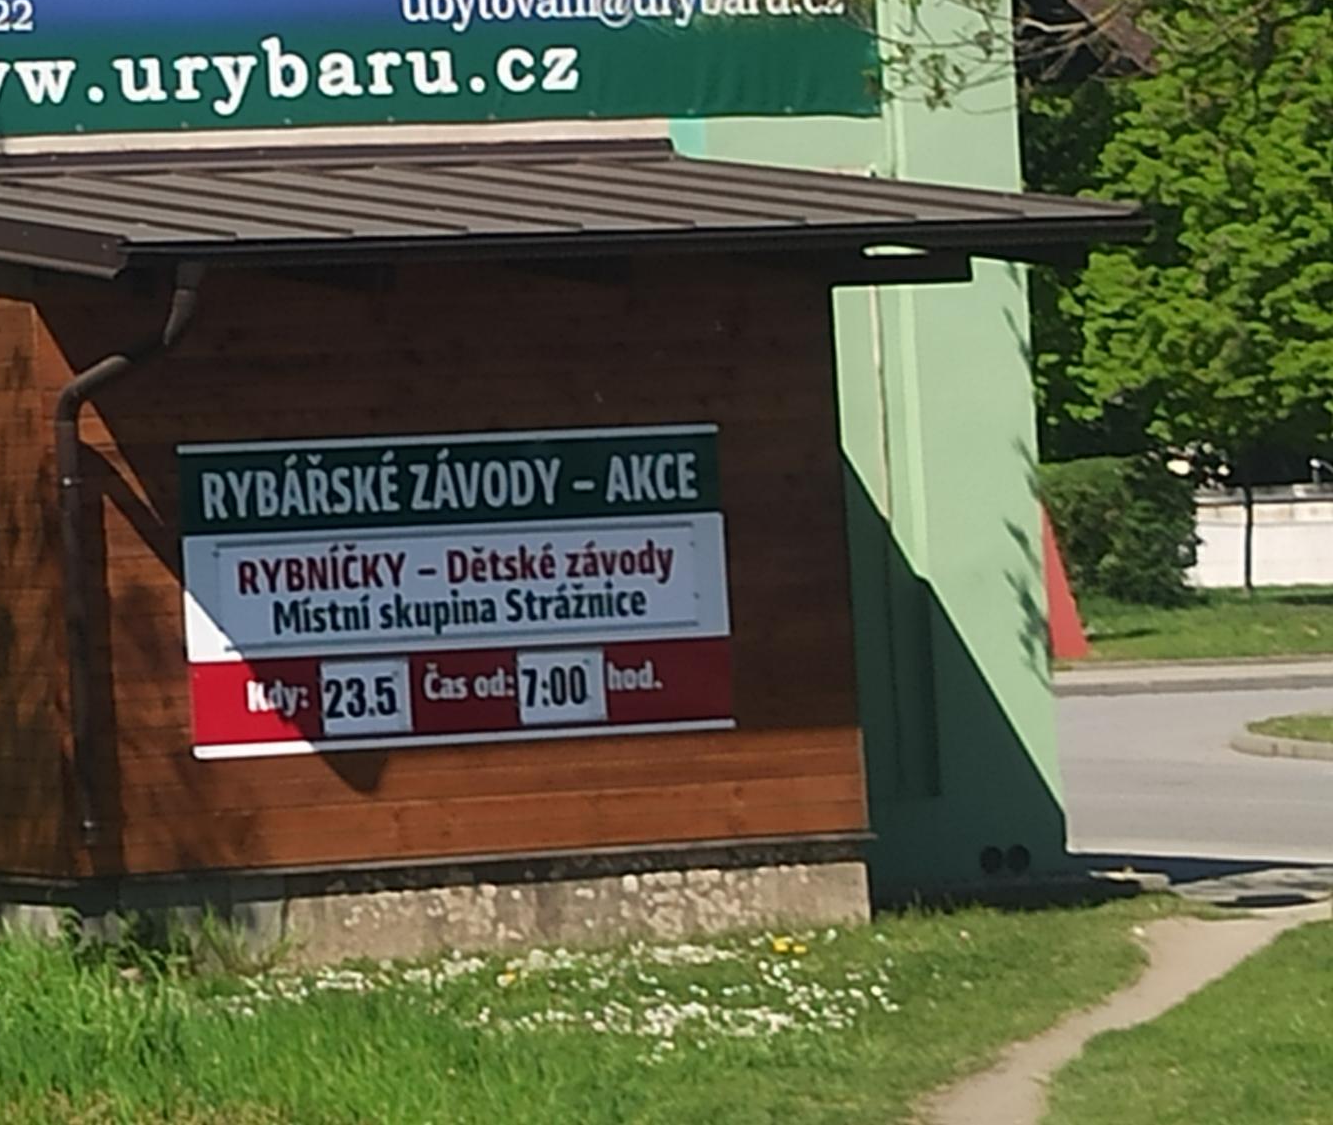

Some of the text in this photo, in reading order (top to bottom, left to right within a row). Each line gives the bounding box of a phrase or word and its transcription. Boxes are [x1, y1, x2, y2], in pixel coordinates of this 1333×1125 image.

[201, 451, 401, 520] RYBÁŘSKÉ
[410, 451, 561, 509] ZÁVODY
[605, 452, 698, 503] AKCE
[237, 543, 406, 595] RYBNÍČKY
[447, 546, 556, 584] Dětské
[565, 540, 674, 584] závody
[273, 582, 647, 635] Místní skupina Strážnice
[247, 660, 663, 719] Kdy: 23.5 Čas od: 7:00 hod.
